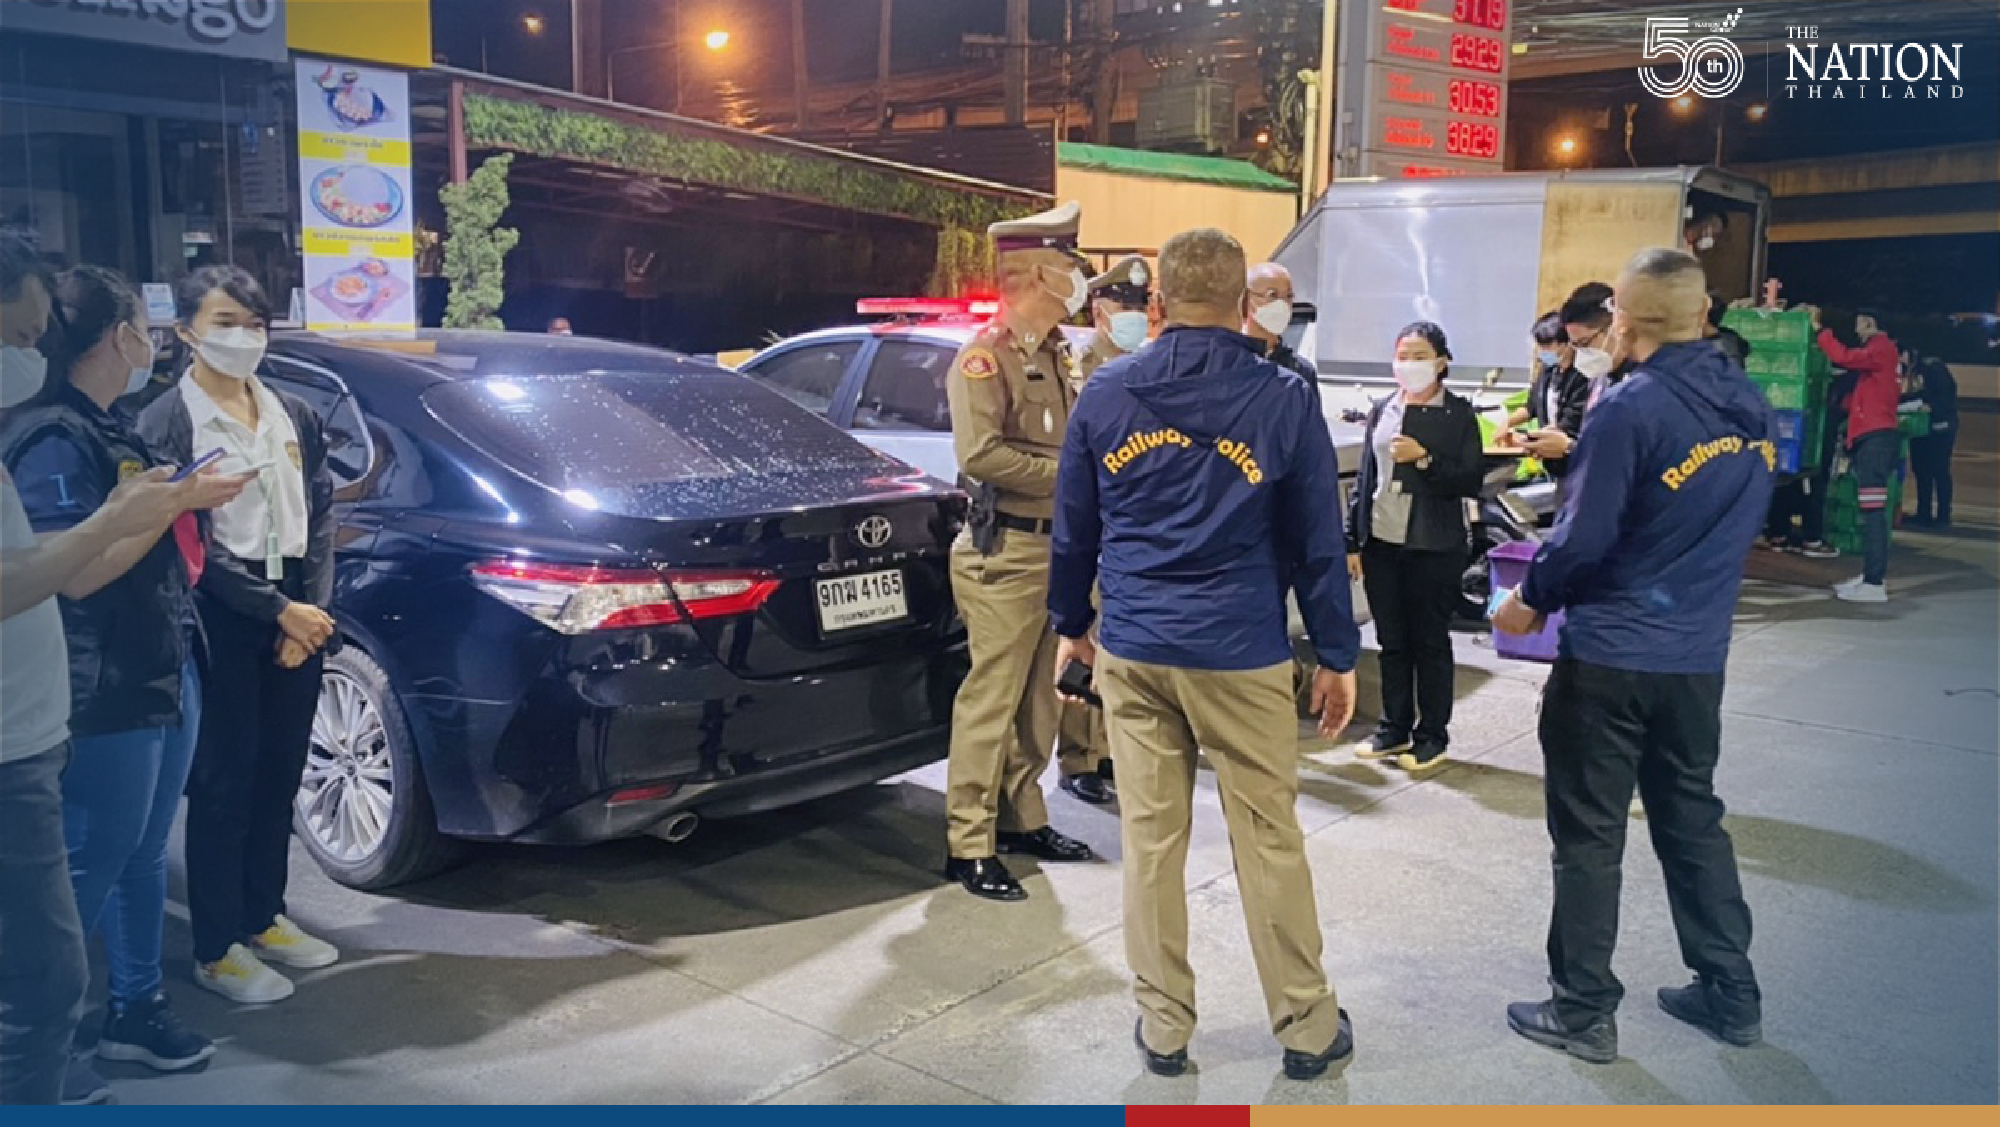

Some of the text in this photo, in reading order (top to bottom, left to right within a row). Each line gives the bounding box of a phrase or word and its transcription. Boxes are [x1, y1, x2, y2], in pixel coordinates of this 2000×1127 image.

[1103, 428, 1264, 485] Railway olice
[1661, 434, 1743, 490] Railway
[861, 573, 901, 600] 4165
